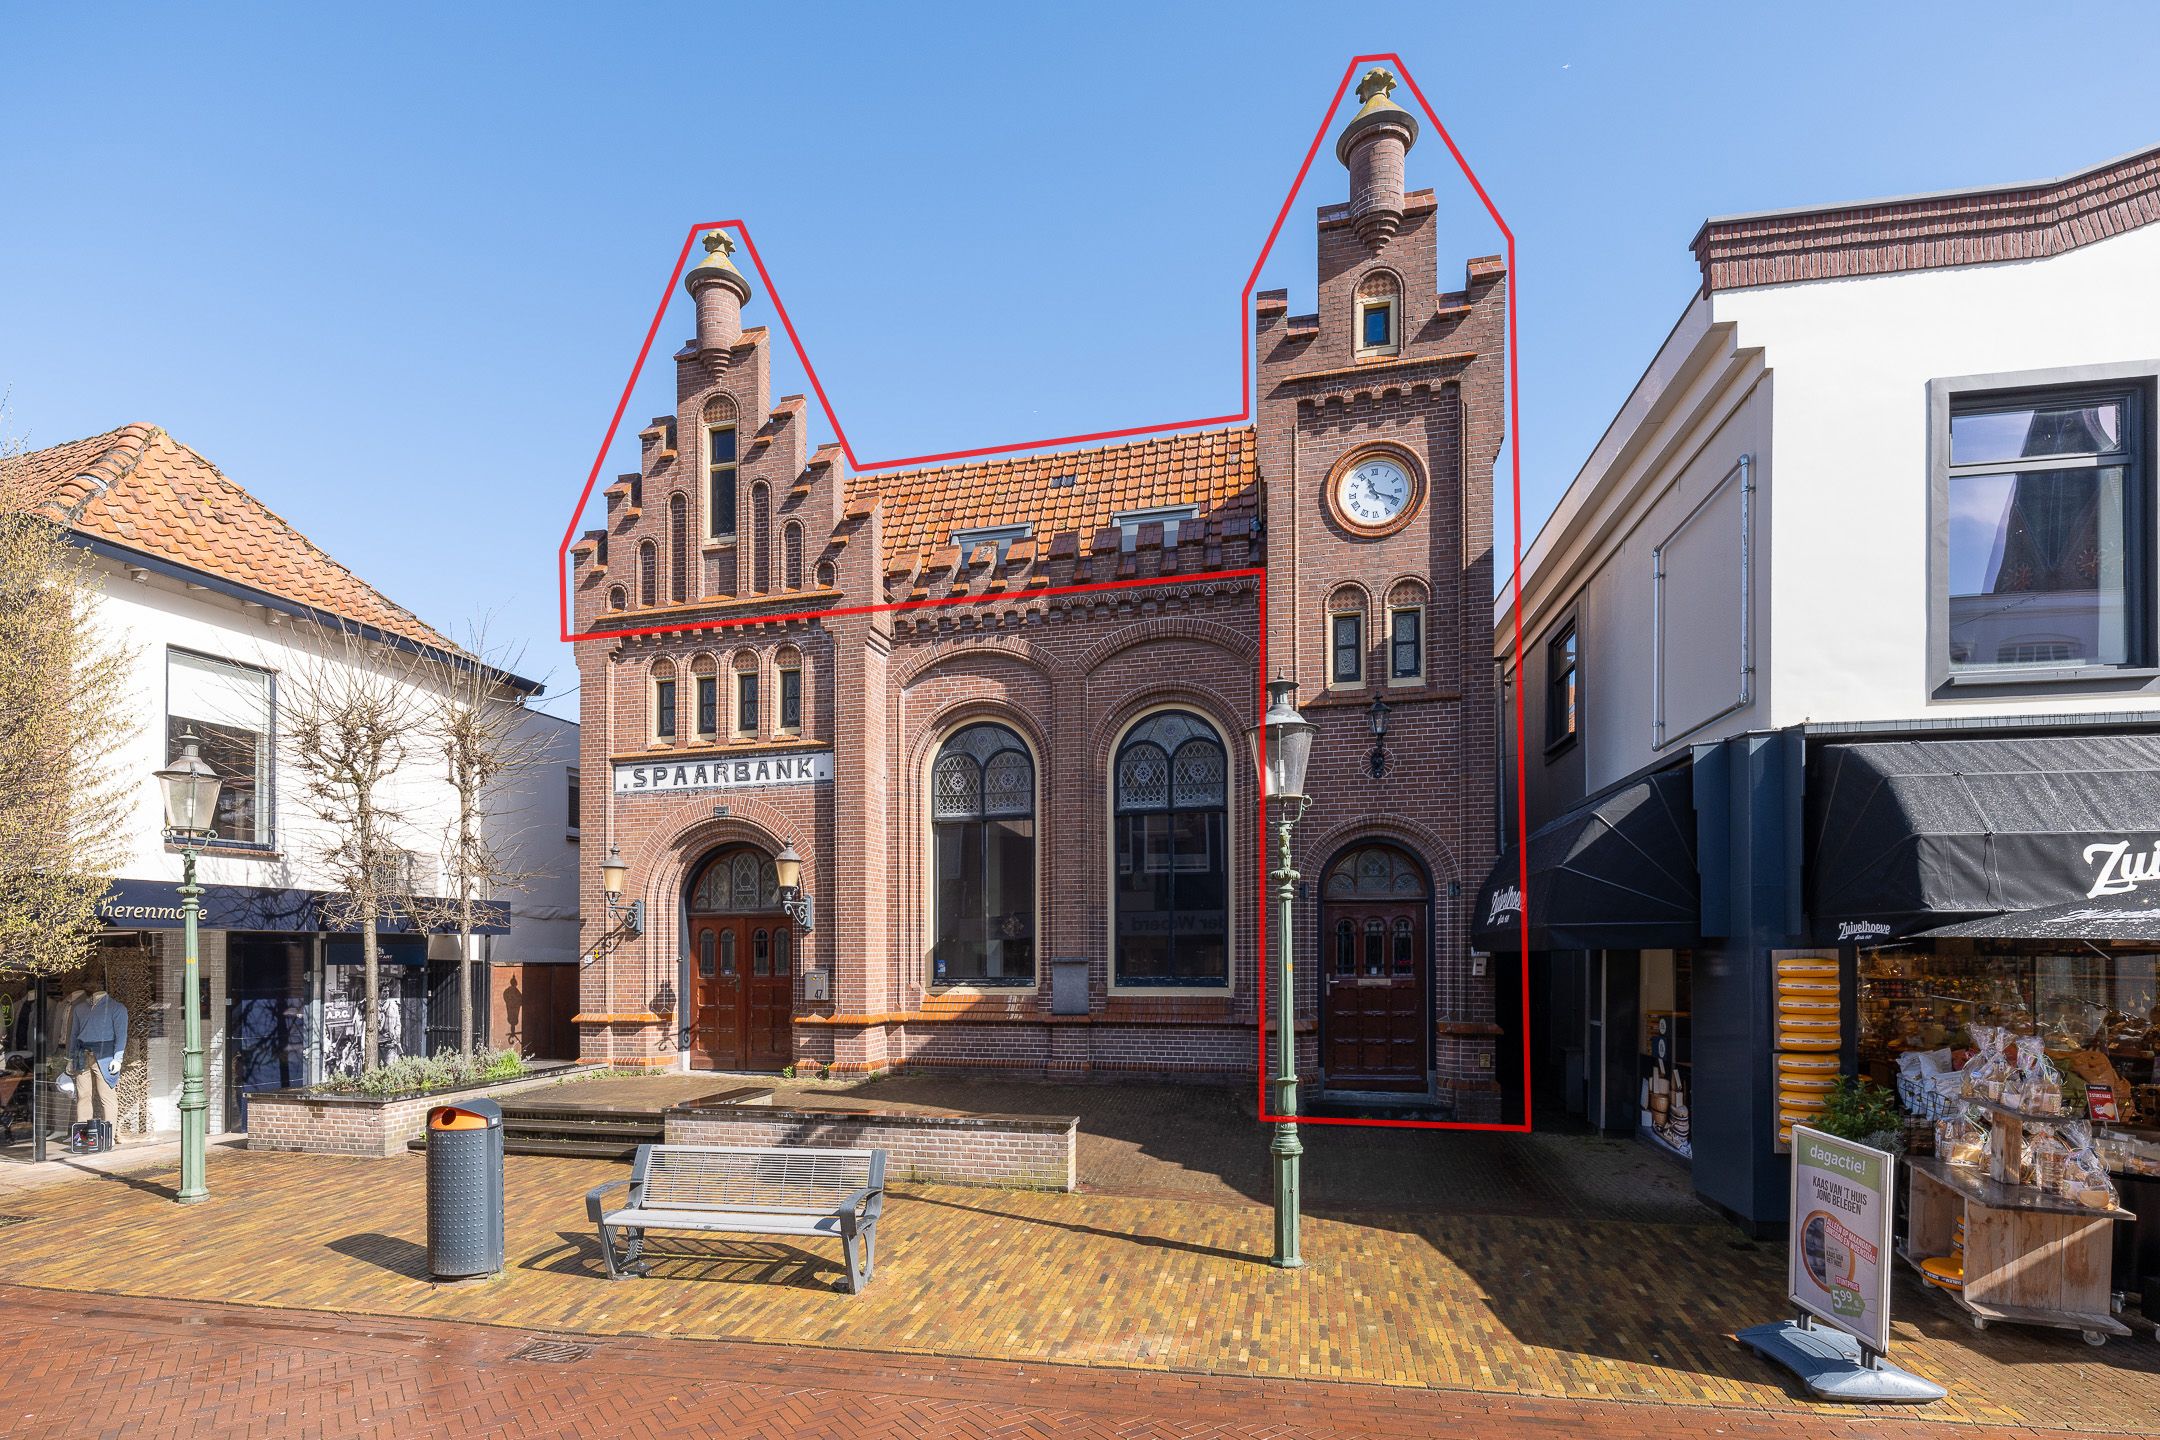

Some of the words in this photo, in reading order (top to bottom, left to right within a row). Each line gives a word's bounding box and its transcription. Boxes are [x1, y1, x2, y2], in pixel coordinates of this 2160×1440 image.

[633, 757, 813, 789] SPAARBANK
[100, 900, 208, 920] herenmoe
[1838, 920, 1891, 940] Zuivelhoeve
[815, 989, 823, 1000] 47
[1810, 1144, 1866, 1175] dagactie!
[1812, 1175, 1829, 1191] KAAS
[1830, 1182, 1843, 1197] VAN
[1843, 1187, 1850, 1199] 'T
[1851, 1190, 1868, 1206] HUIS
[1816, 1189, 1832, 1204] JONG
[1832, 1195, 1862, 1216] BELEGEN
